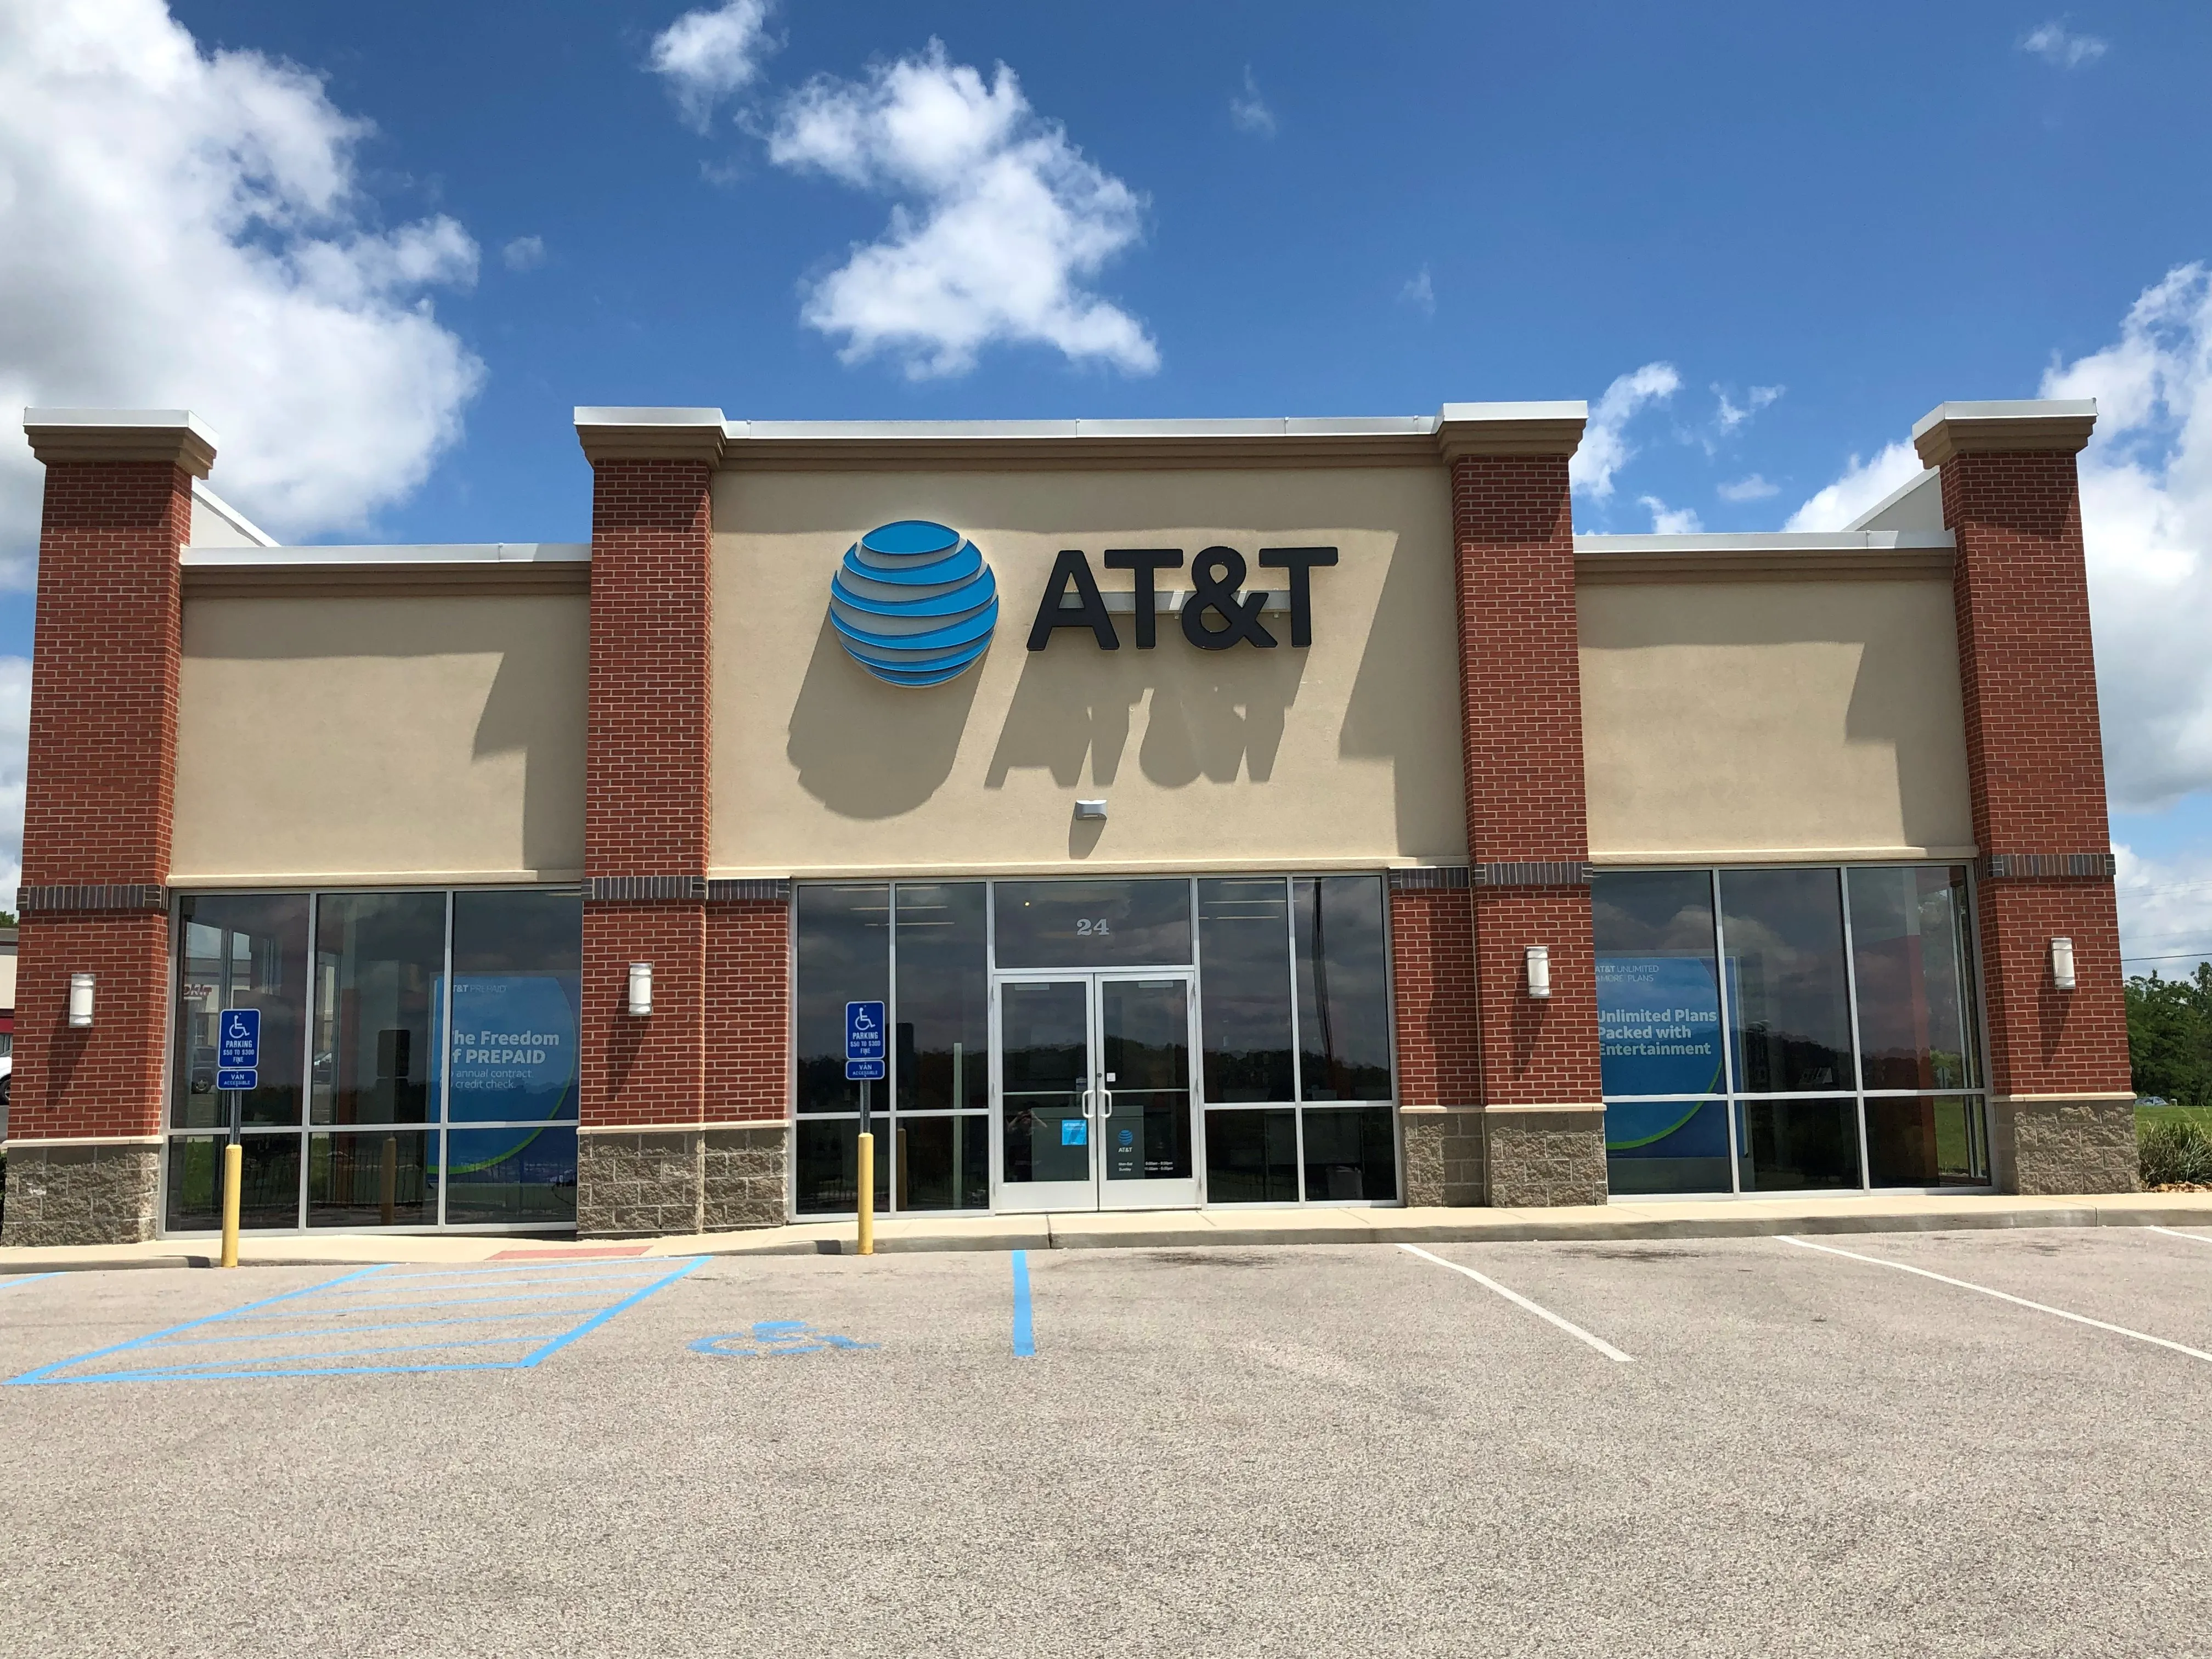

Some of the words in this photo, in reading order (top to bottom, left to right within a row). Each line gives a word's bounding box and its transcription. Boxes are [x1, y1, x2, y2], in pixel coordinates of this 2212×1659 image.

[1026, 545, 1338, 651] AT&T
[1077, 918, 1109, 935] 24
[1598, 1008, 1671, 1023] Unlimited
[1675, 1008, 1717, 1022] Plans
[452, 1030, 476, 1045] he
[481, 1030, 560, 1046] Freedom
[1599, 1025, 1652, 1039] Packed
[1655, 1025, 1692, 1039] with
[466, 1049, 546, 1064] PREPAID
[1599, 1042, 1712, 1056] Entertainment
[456, 1069, 488, 1078] annual
[455, 1079, 483, 1089] credit
[486, 1079, 516, 1089] check.
